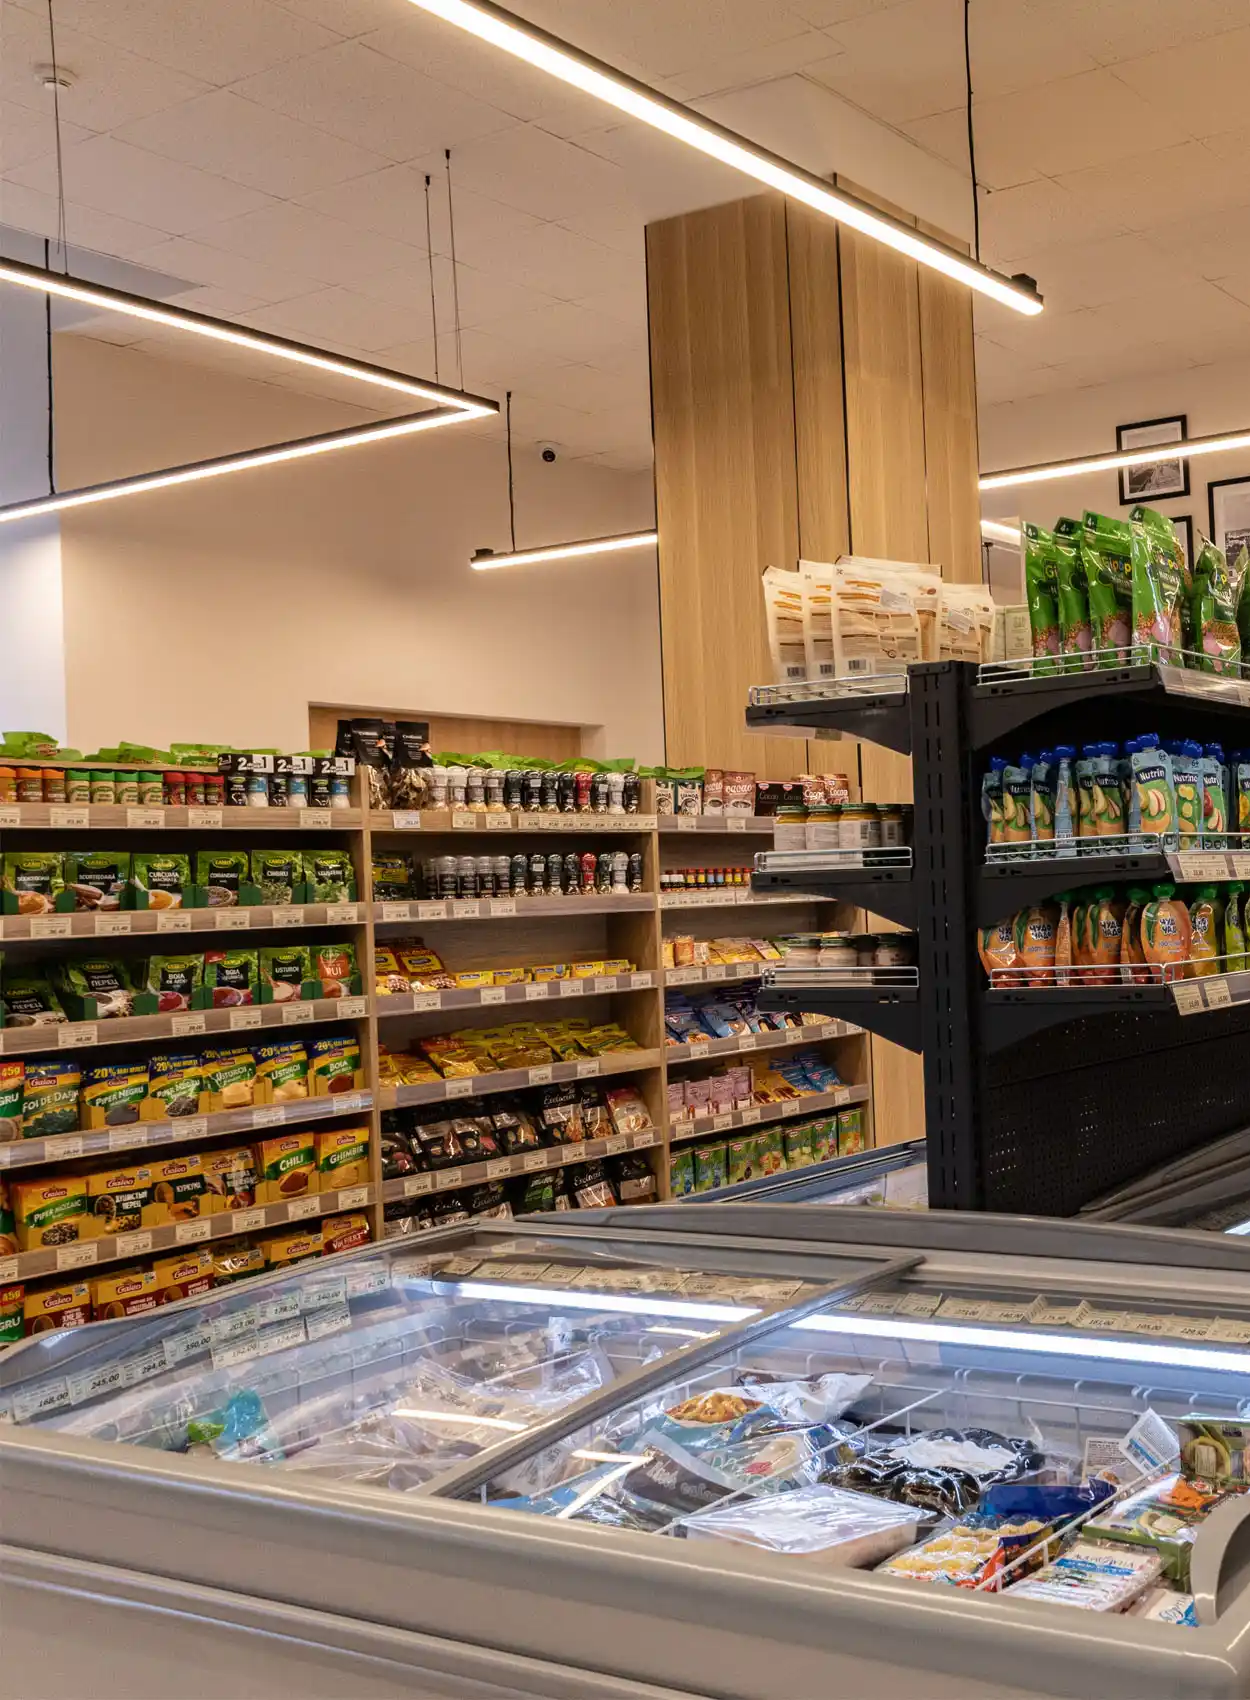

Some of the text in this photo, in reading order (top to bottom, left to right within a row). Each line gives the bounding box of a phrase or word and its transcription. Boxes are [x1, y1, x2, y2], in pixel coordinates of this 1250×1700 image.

[1139, 770, 1164, 782] Nutrin
[96, 1086, 144, 1106] PIPER NEGRU
[22, 1100, 40, 1116] FOI
[280, 1153, 304, 1171] CHILI
[330, 1144, 364, 1164] GHIMBIR
[0, 1316, 20, 1332] GRU
